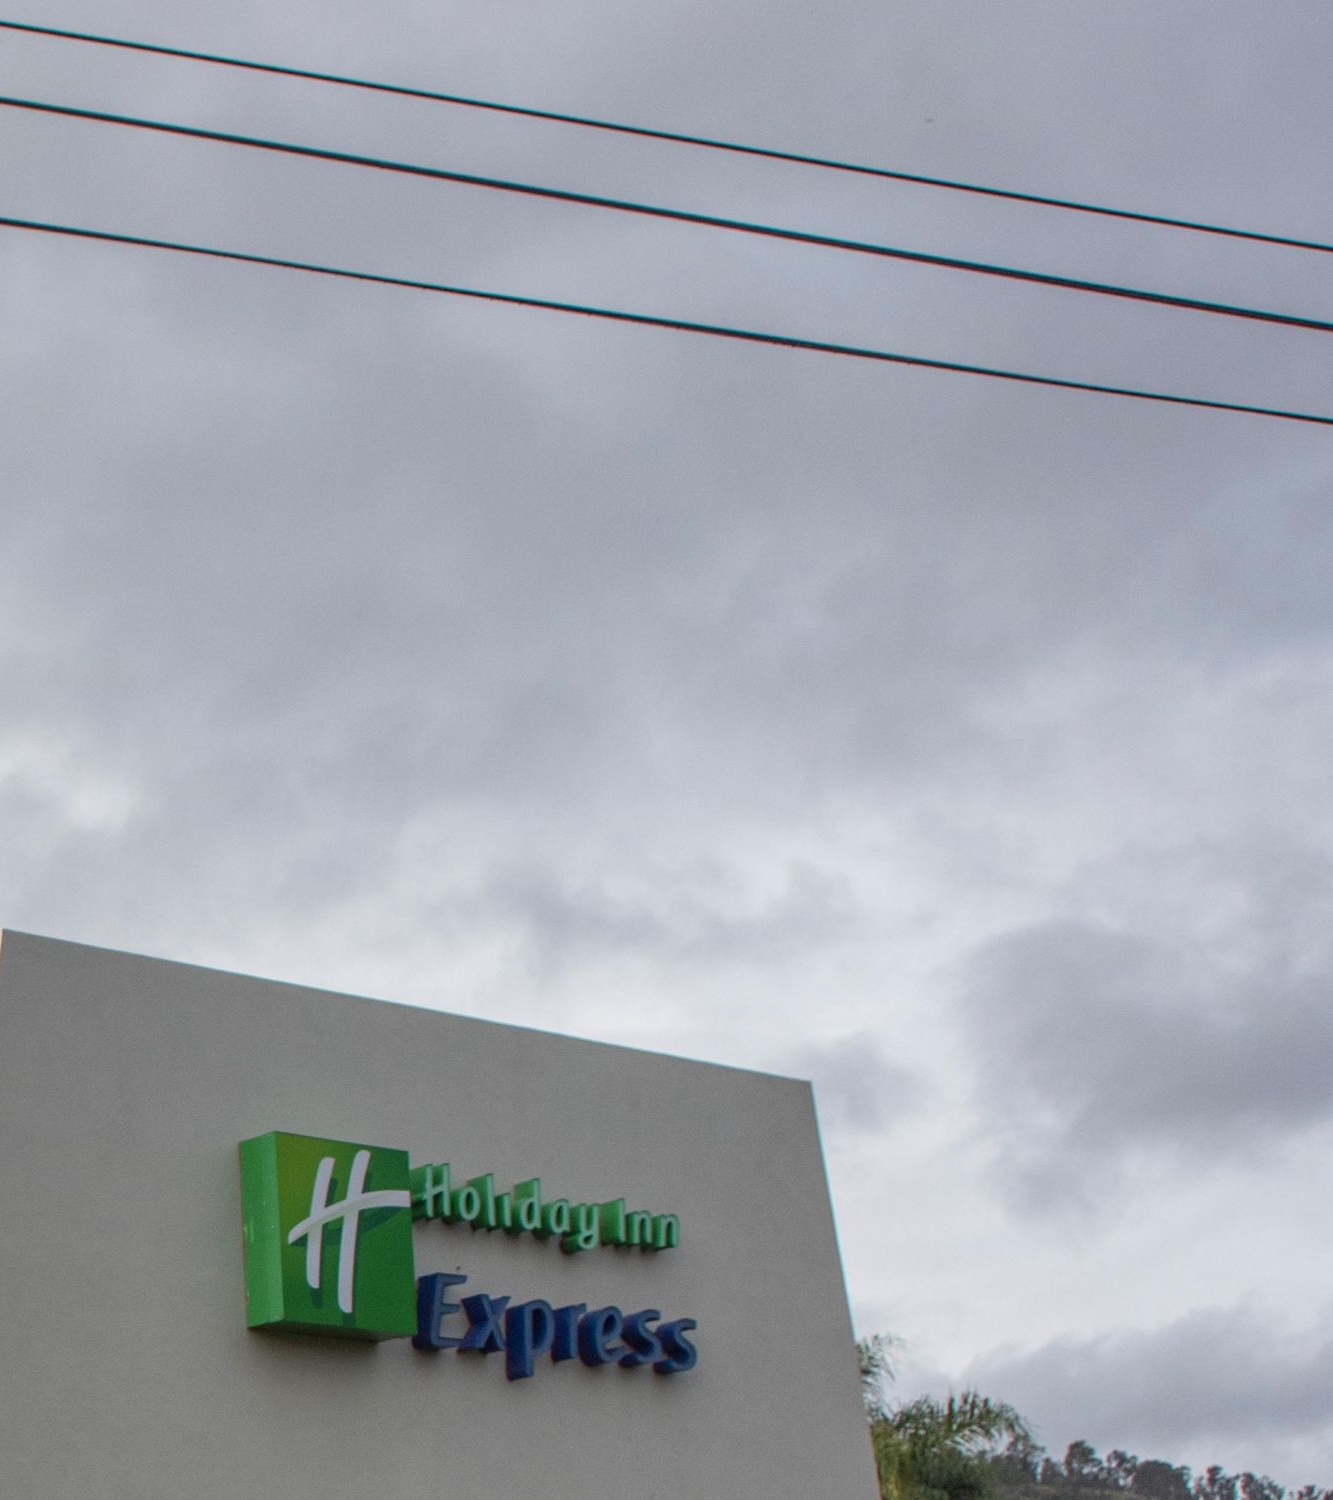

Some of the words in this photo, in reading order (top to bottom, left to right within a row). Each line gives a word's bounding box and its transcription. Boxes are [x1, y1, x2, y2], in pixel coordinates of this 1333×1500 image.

[288, 1149, 411, 1313] H
[412, 1162, 600, 1254] Holiday
[601, 1197, 680, 1251] Inn
[413, 1271, 699, 1381] Express
